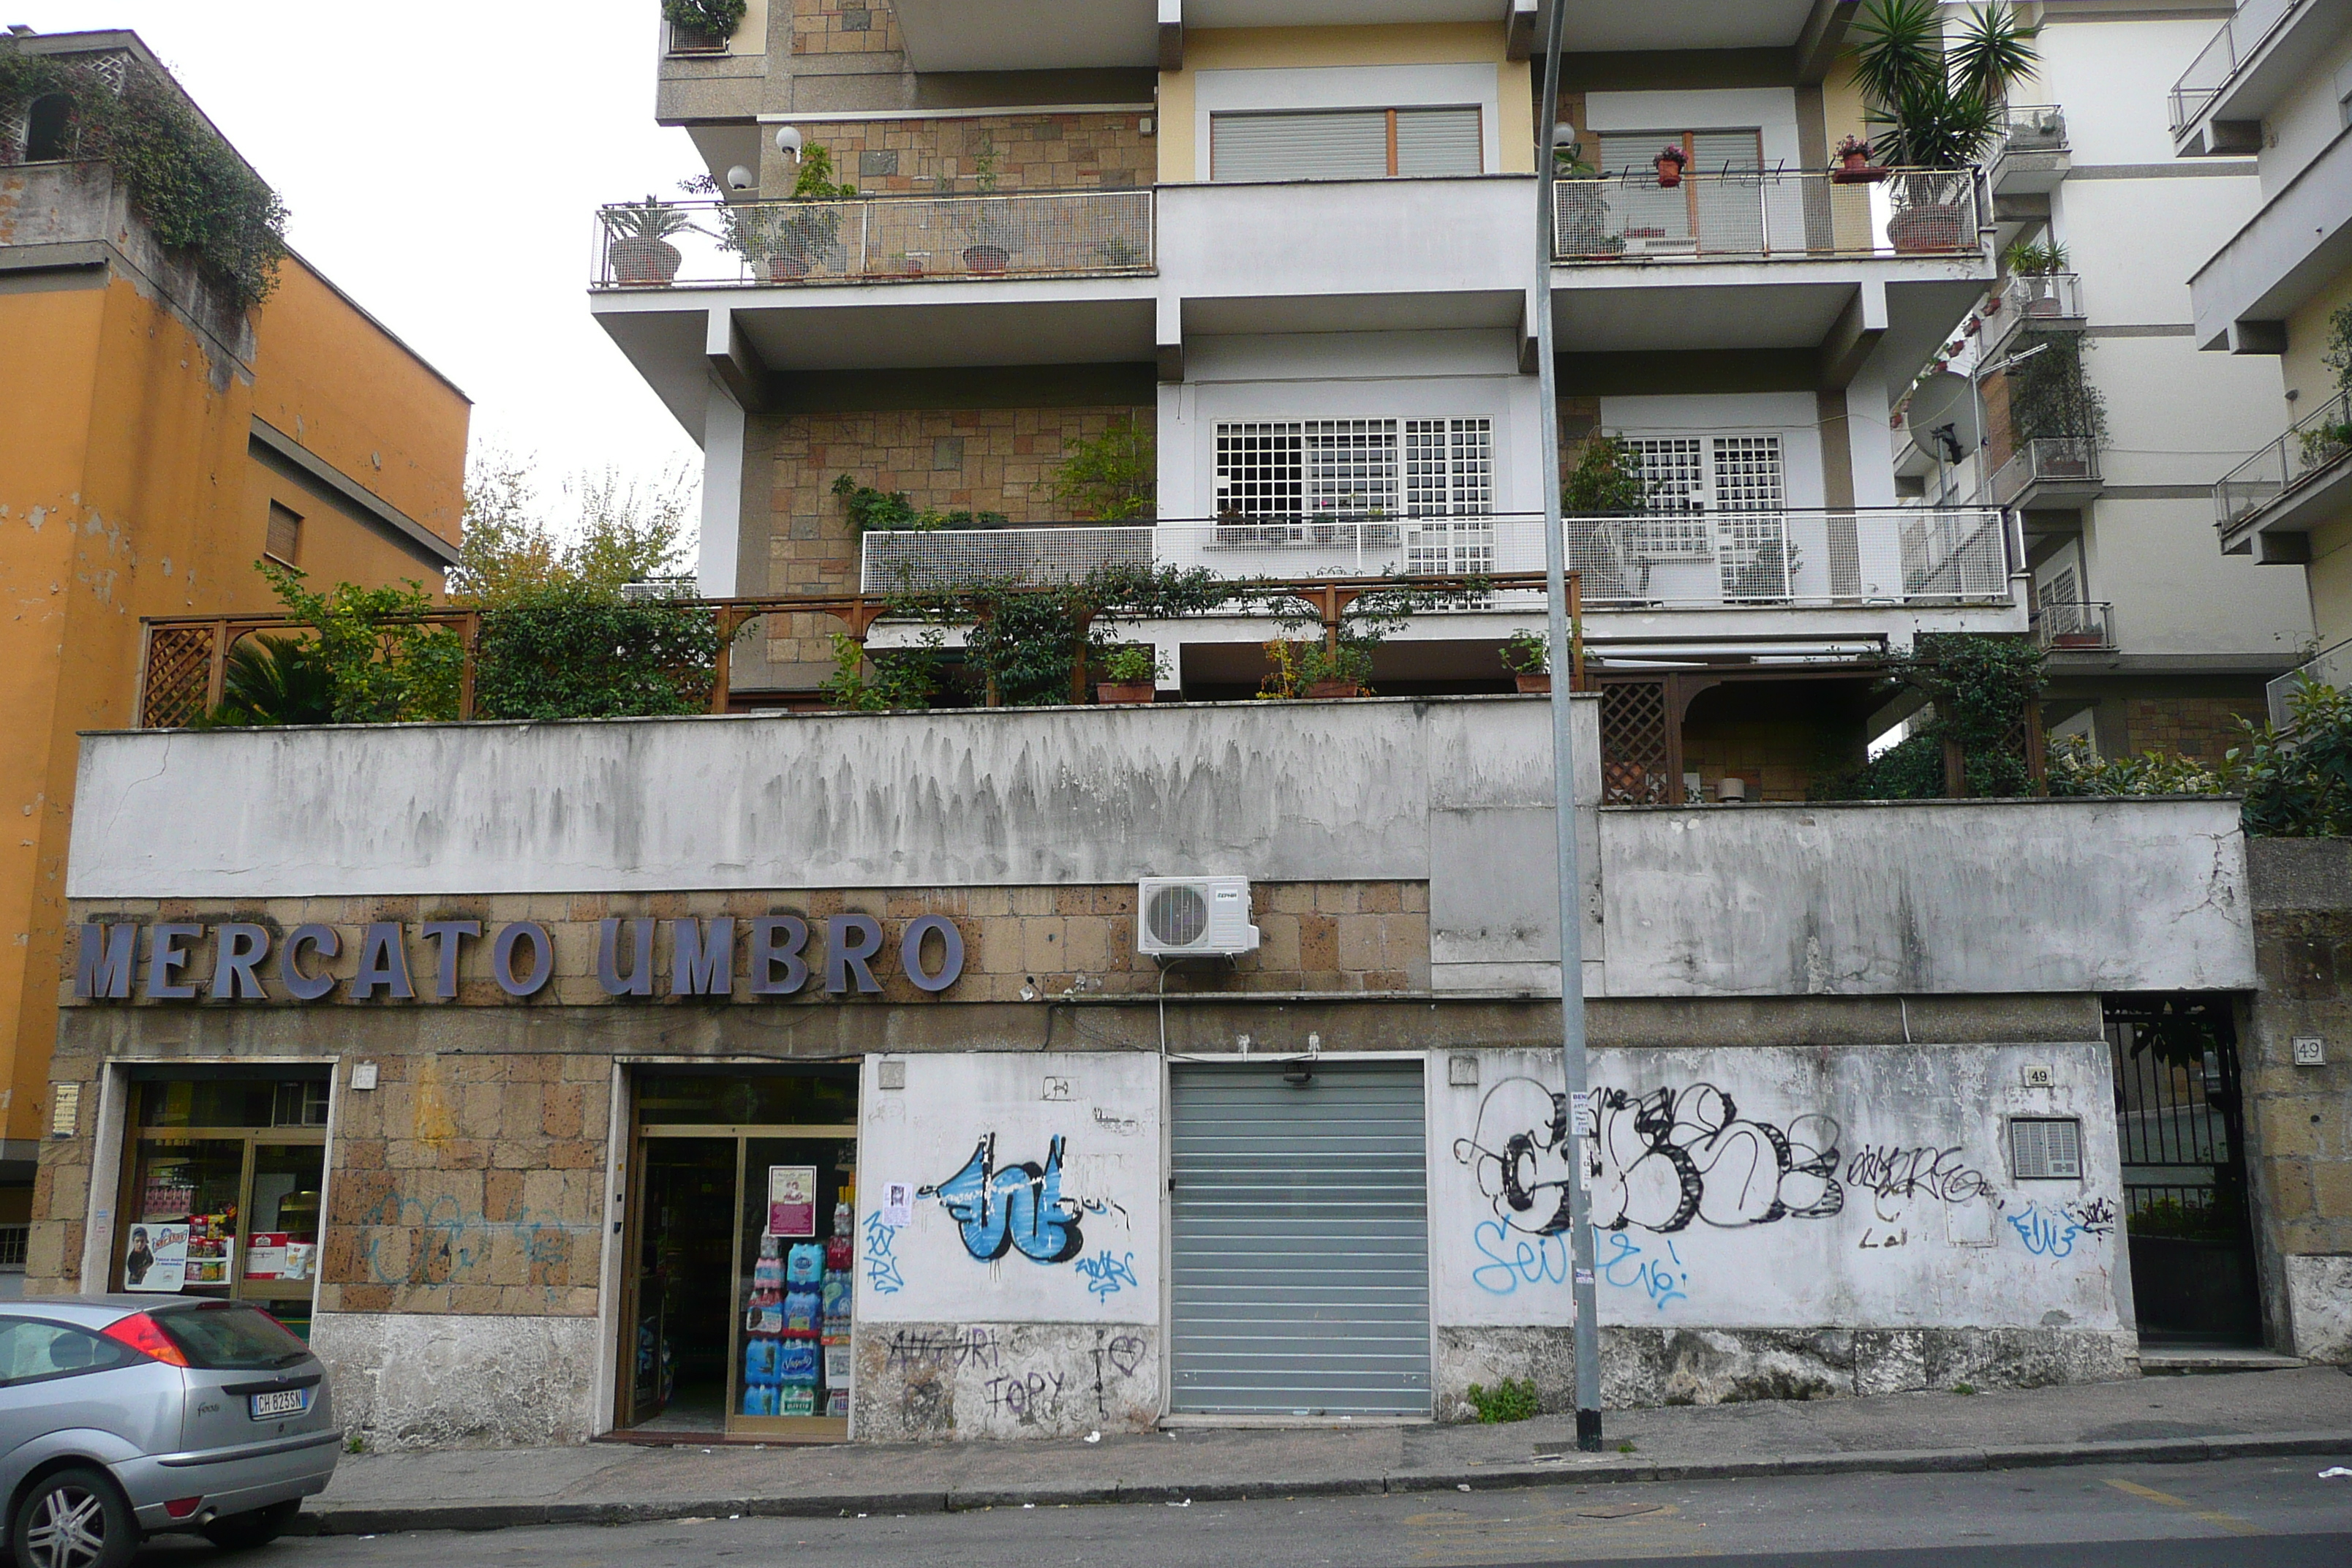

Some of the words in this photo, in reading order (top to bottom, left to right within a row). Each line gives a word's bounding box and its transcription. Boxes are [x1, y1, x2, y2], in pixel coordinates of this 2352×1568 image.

[74, 919, 556, 1000] MERCATO
[597, 913, 965, 996] UMBRO
[2299, 1041, 2320, 1058] 49
[2031, 1071, 2048, 1082] 49
[258, 1394, 271, 1414] CH
[273, 1390, 301, 1412] 823SN
